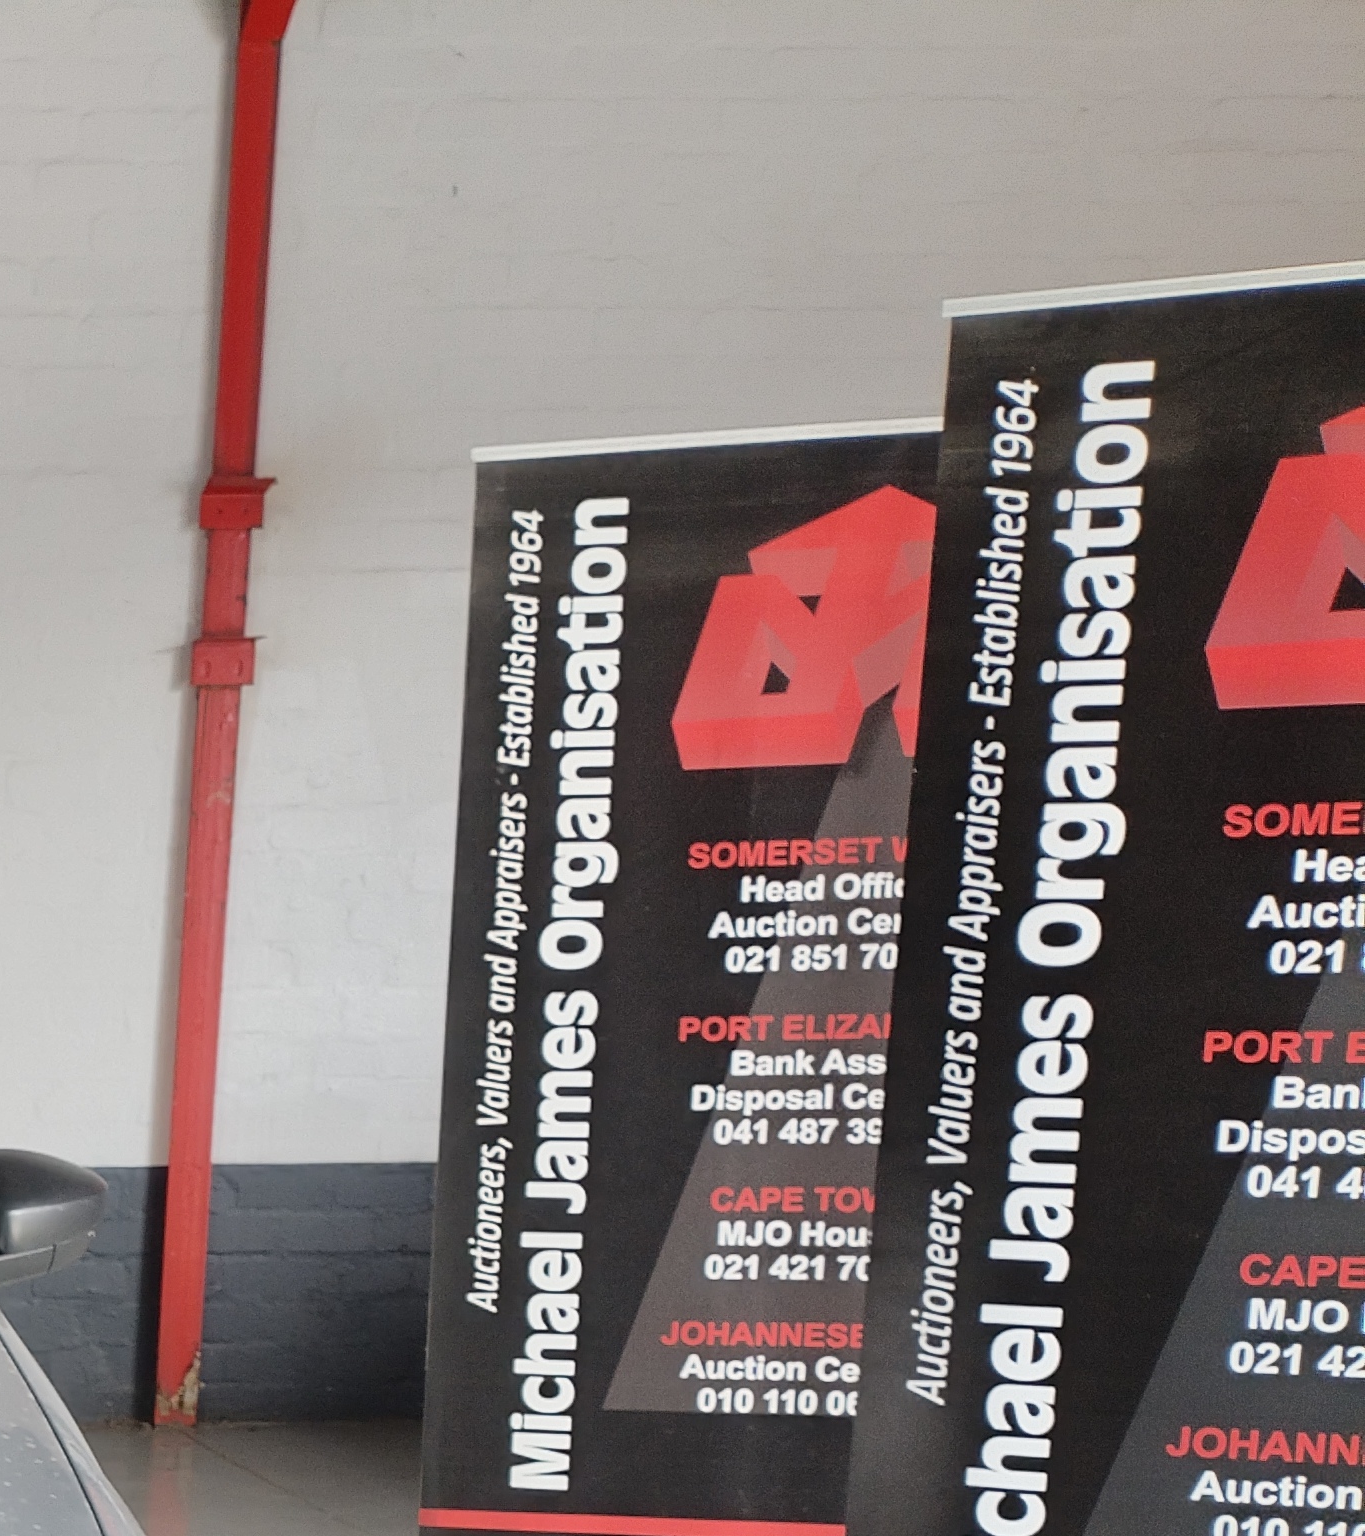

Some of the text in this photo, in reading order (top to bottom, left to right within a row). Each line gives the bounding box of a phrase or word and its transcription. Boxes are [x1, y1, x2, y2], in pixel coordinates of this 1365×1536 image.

[990, 377, 1039, 478] 1964
[509, 509, 544, 590] 1964
[968, 485, 1029, 708] Established
[496, 594, 539, 768] Established
[1018, 359, 1156, 968] Organisation
[688, 837, 882, 869] SOMERSET
[948, 738, 1006, 941] Appraisers
[486, 791, 529, 950] Appraisers
[739, 874, 825, 903] Head
[708, 910, 838, 939] Auction
[725, 943, 898, 973] 021 851 70
[1268, 939, 1345, 975] 021
[486, 955, 518, 1013] and
[510, 497, 630, 1491] Michael James Organisation
[943, 947, 987, 1022] and
[678, 1015, 773, 1042] PORT
[1203, 1029, 1334, 1065] PORT
[476, 1018, 515, 1127] Valuers
[731, 1049, 887, 1076] Bank Ass
[691, 1083, 885, 1116] Disposal Ce
[925, 1025, 978, 1167] Valuers
[713, 1118, 839, 1145] 041 487
[988, 993, 1092, 1283] James
[710, 1185, 805, 1213] CAPE
[1247, 1164, 1321, 1199] 041
[466, 1136, 512, 1313] Auctioneers,
[717, 1219, 793, 1247] MJO
[704, 1254, 826, 1281] 021 421
[1239, 1253, 1365, 1290] CAPE
[905, 1180, 972, 1405] Auctioneers,
[1247, 1297, 1349, 1334] MJO
[679, 1353, 860, 1383] Auction Ce
[1229, 1341, 1303, 1376] 021
[697, 1387, 818, 1415] 010 110
[1190, 1470, 1363, 1511] Auction
